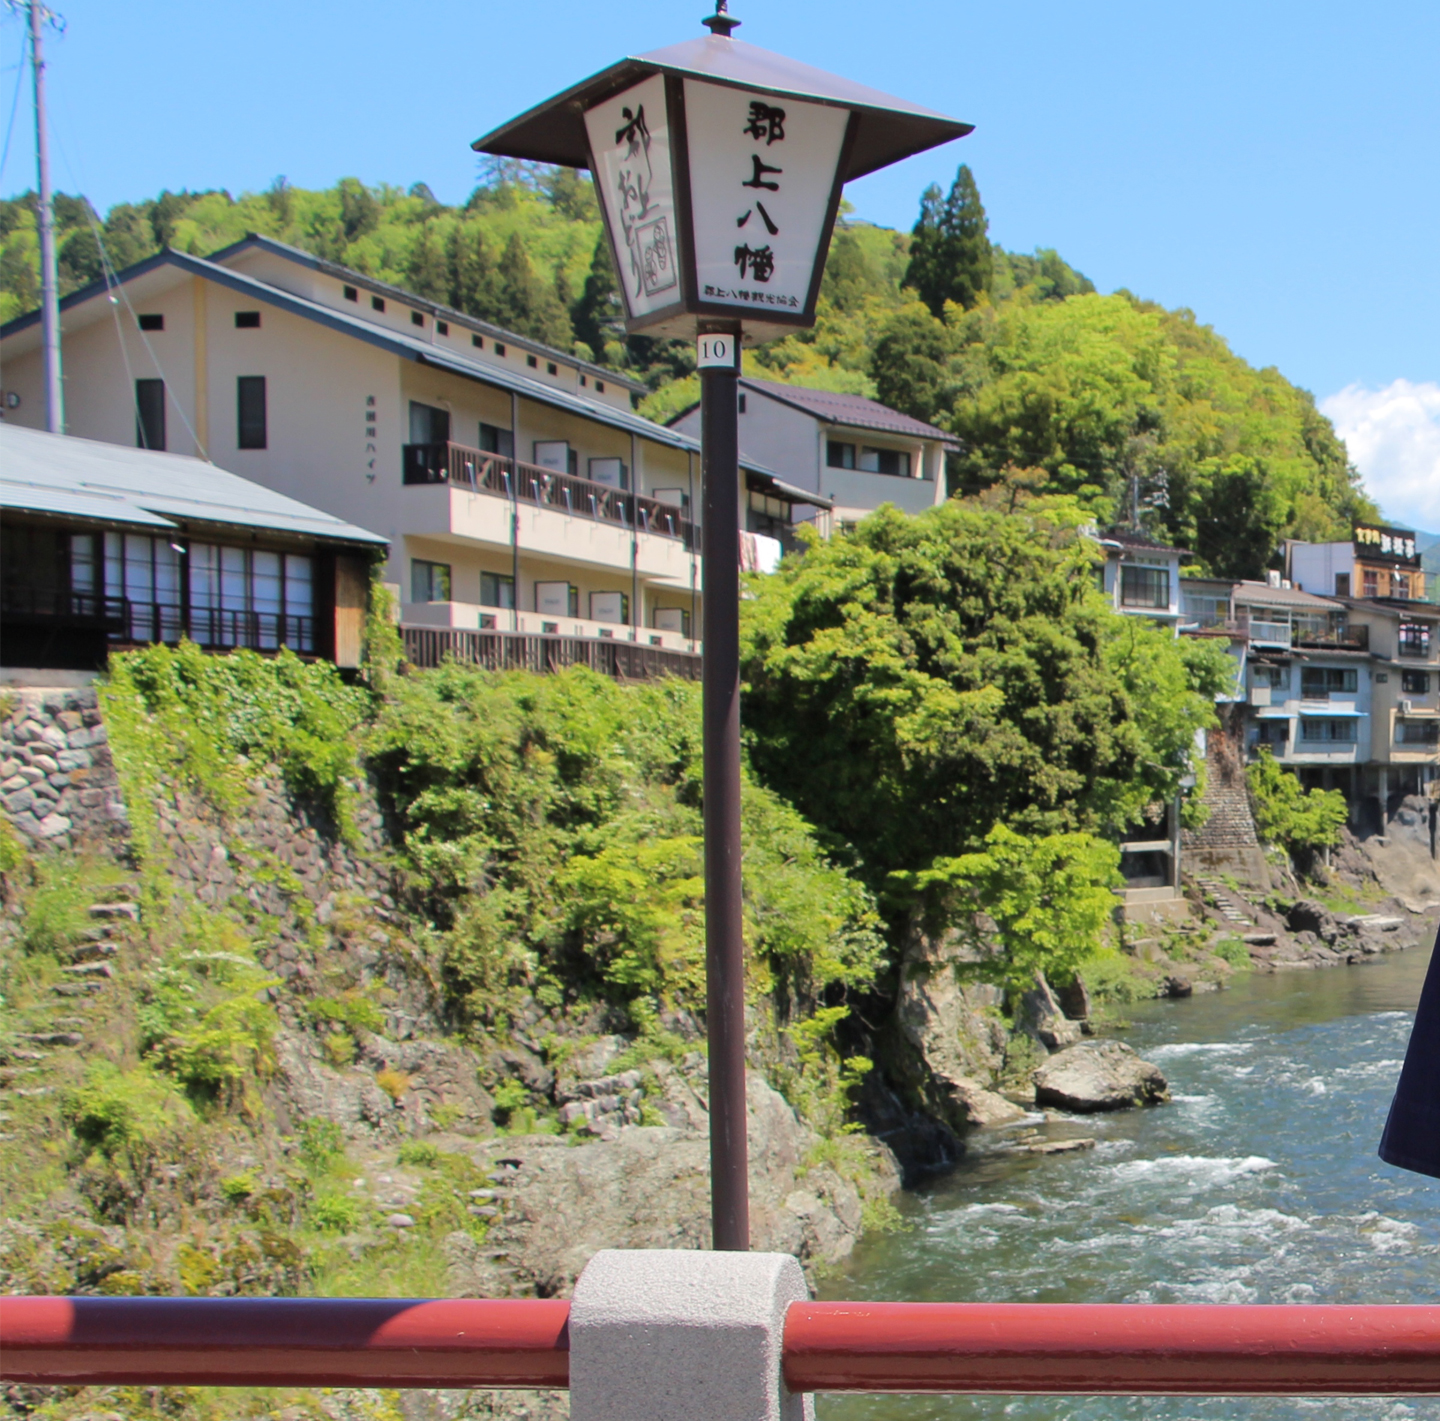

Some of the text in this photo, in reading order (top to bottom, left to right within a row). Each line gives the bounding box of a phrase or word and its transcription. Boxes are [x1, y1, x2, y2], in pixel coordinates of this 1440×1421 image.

[733, 101, 786, 283] 郡上八幡
[704, 284, 800, 308] 郡上八幡観光協会
[702, 340, 726, 359] 10
